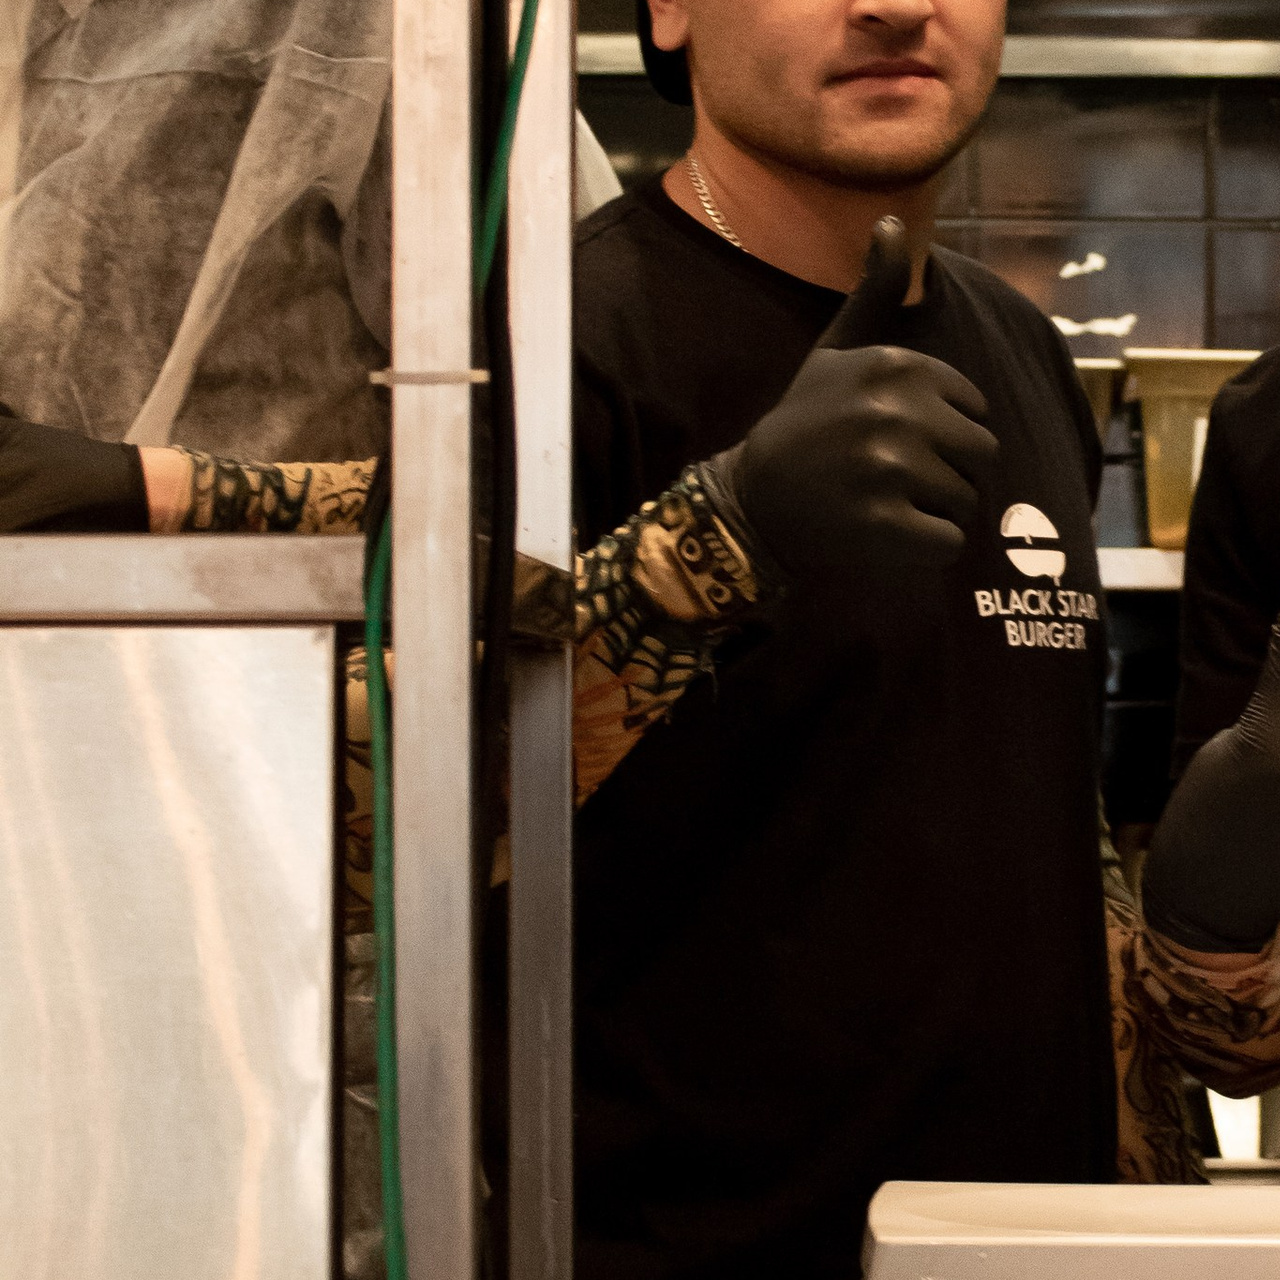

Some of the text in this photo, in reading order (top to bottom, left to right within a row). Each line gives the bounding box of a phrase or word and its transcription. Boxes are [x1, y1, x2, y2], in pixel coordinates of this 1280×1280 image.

[974, 589, 1099, 619] BLACK STAR
[1005, 620, 1086, 649] BURGER
